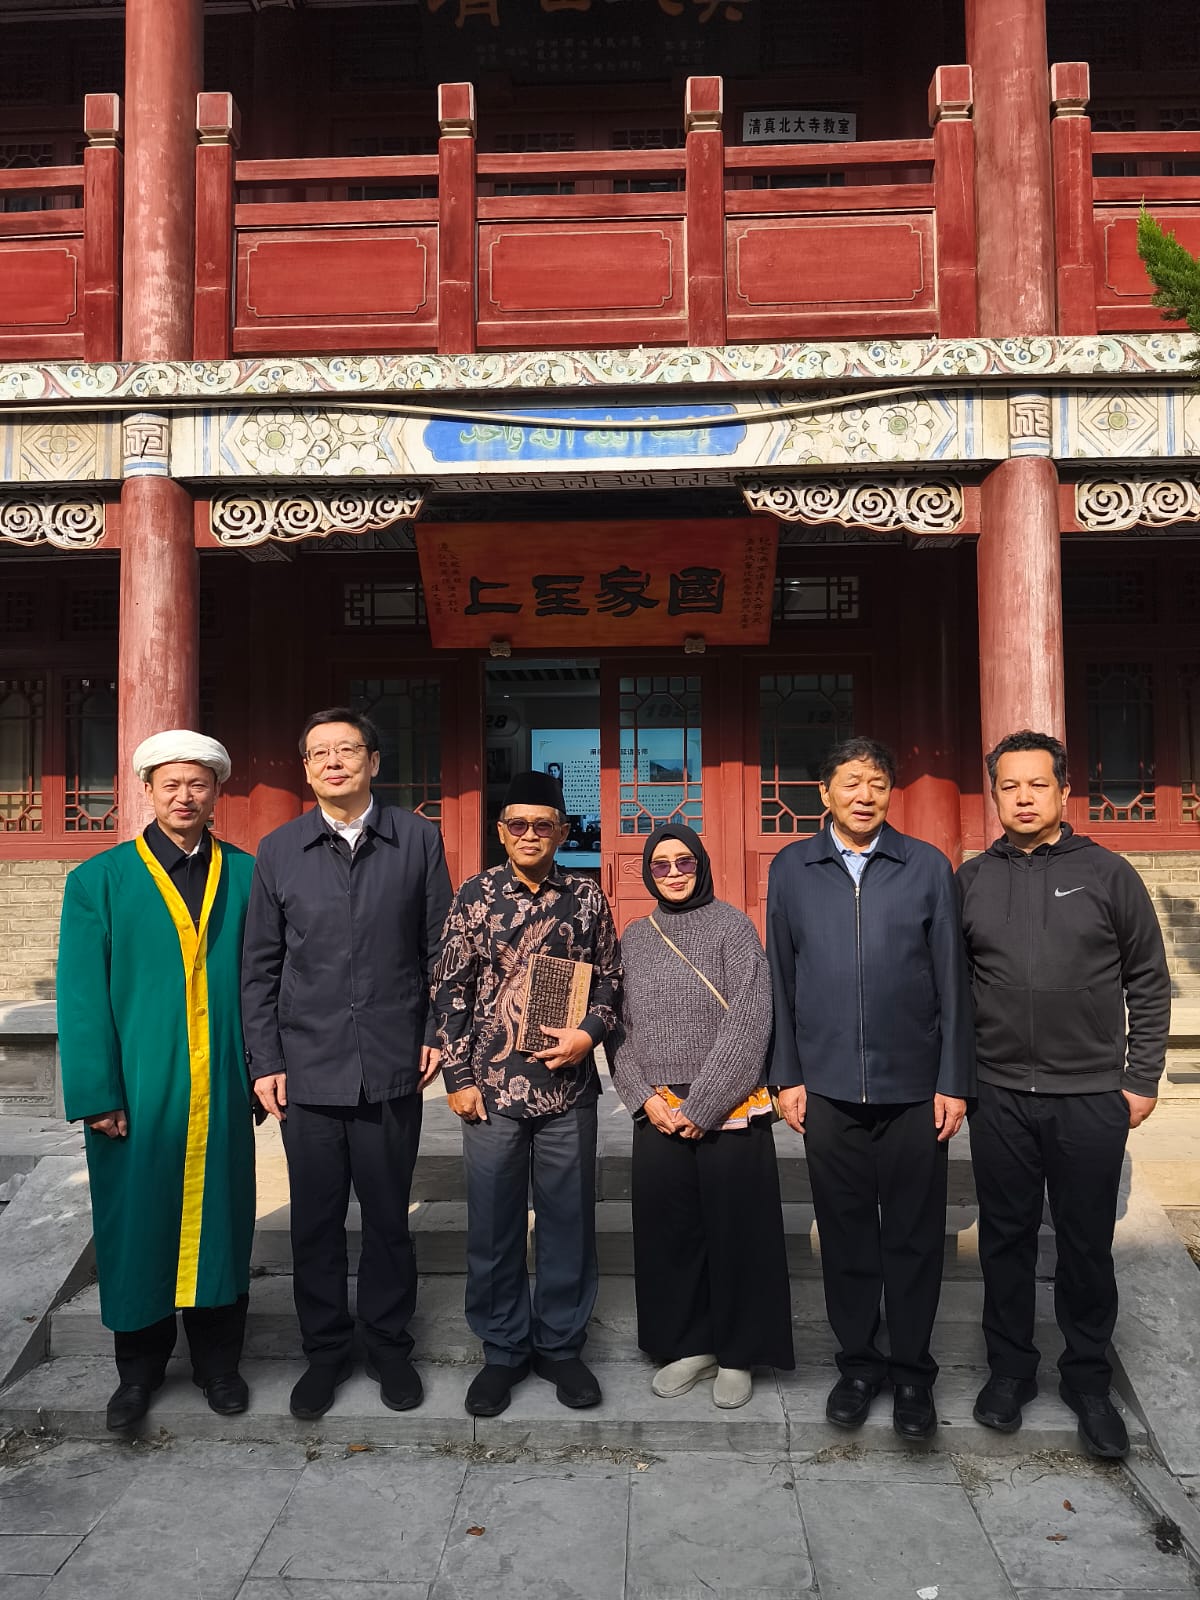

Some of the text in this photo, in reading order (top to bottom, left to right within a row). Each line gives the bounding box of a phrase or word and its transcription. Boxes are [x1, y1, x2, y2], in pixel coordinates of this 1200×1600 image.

[749, 117, 850, 135] 清真北大寺教室
[464, 565, 725, 617] 國家至上
